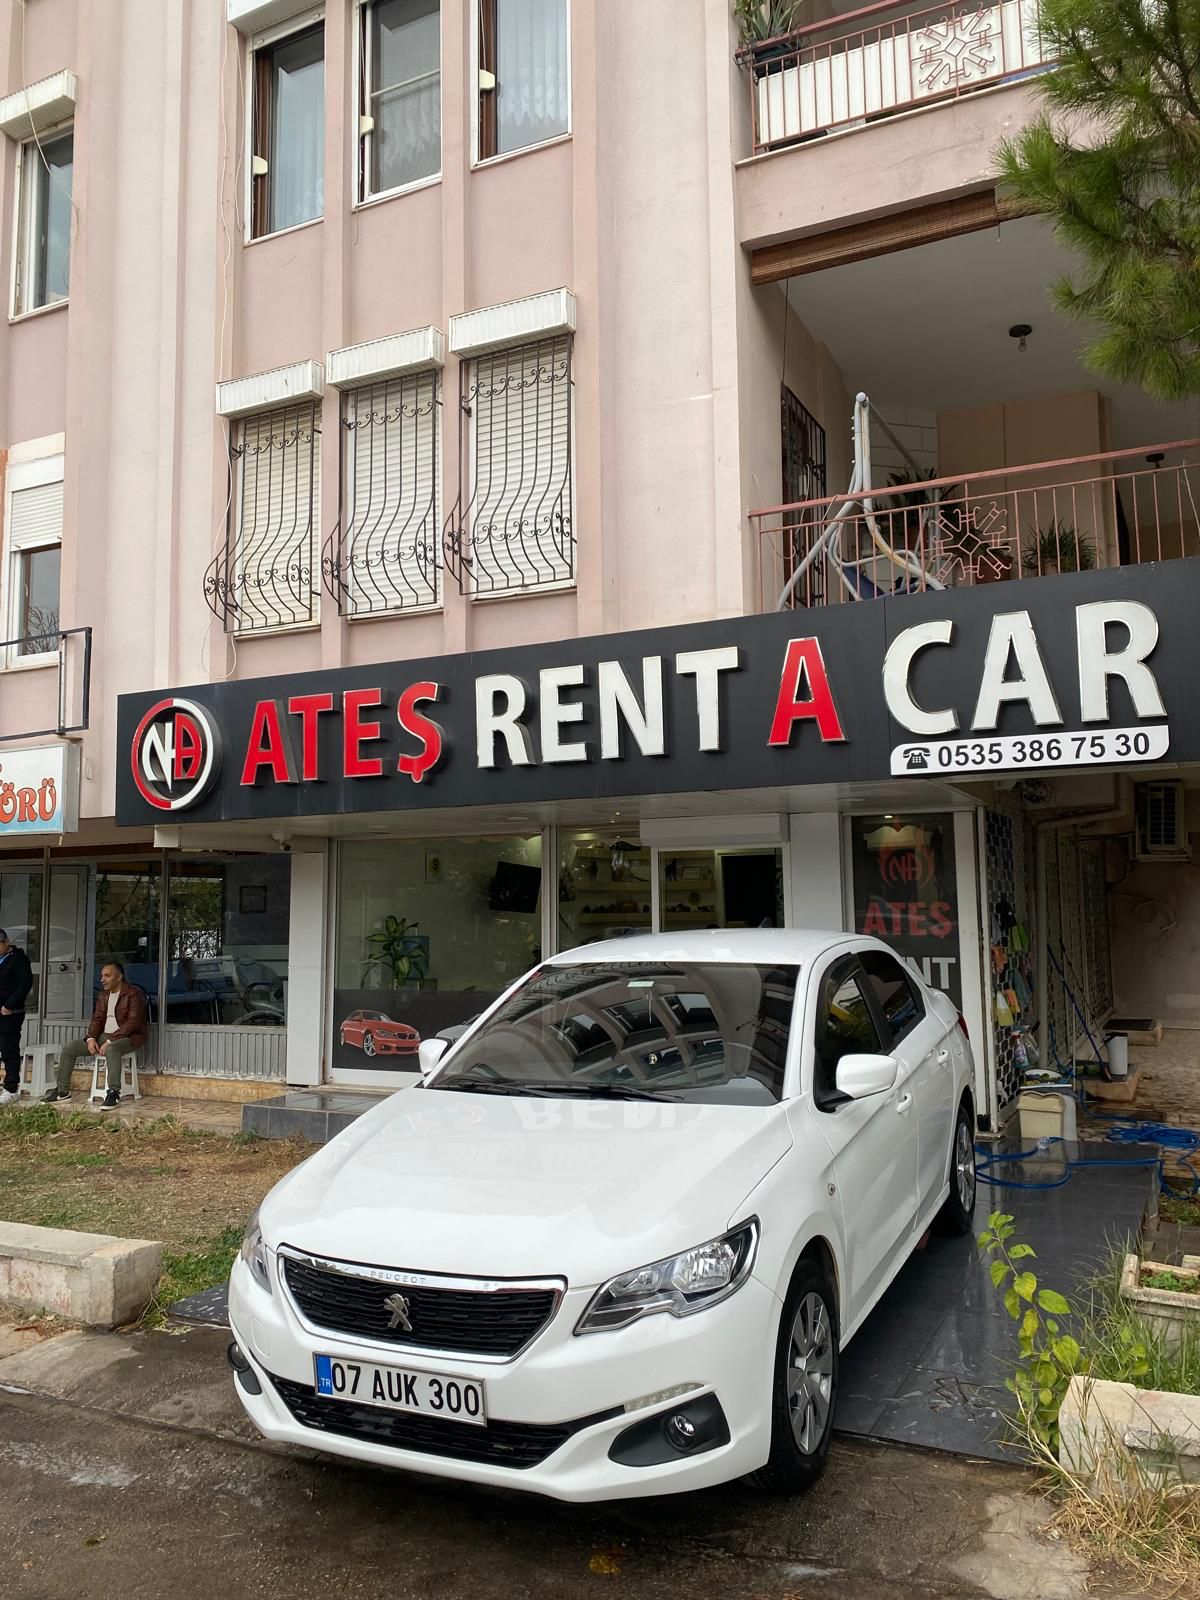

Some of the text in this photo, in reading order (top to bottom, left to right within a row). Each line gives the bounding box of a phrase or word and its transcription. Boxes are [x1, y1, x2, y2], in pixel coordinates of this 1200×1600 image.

[240, 600, 1168, 786] ATEŞ RENT A CAR
[938, 733, 1150, 767] 0535 386 75 30
[0, 777, 57, 824] ÖRÜ
[863, 901, 953, 939] ATEŞ
[901, 956, 957, 990] NT
[370, 1270, 427, 1285] PEUGEOT
[320, 1377, 332, 1389] TR
[332, 1362, 480, 1416] 07 AUK 300
